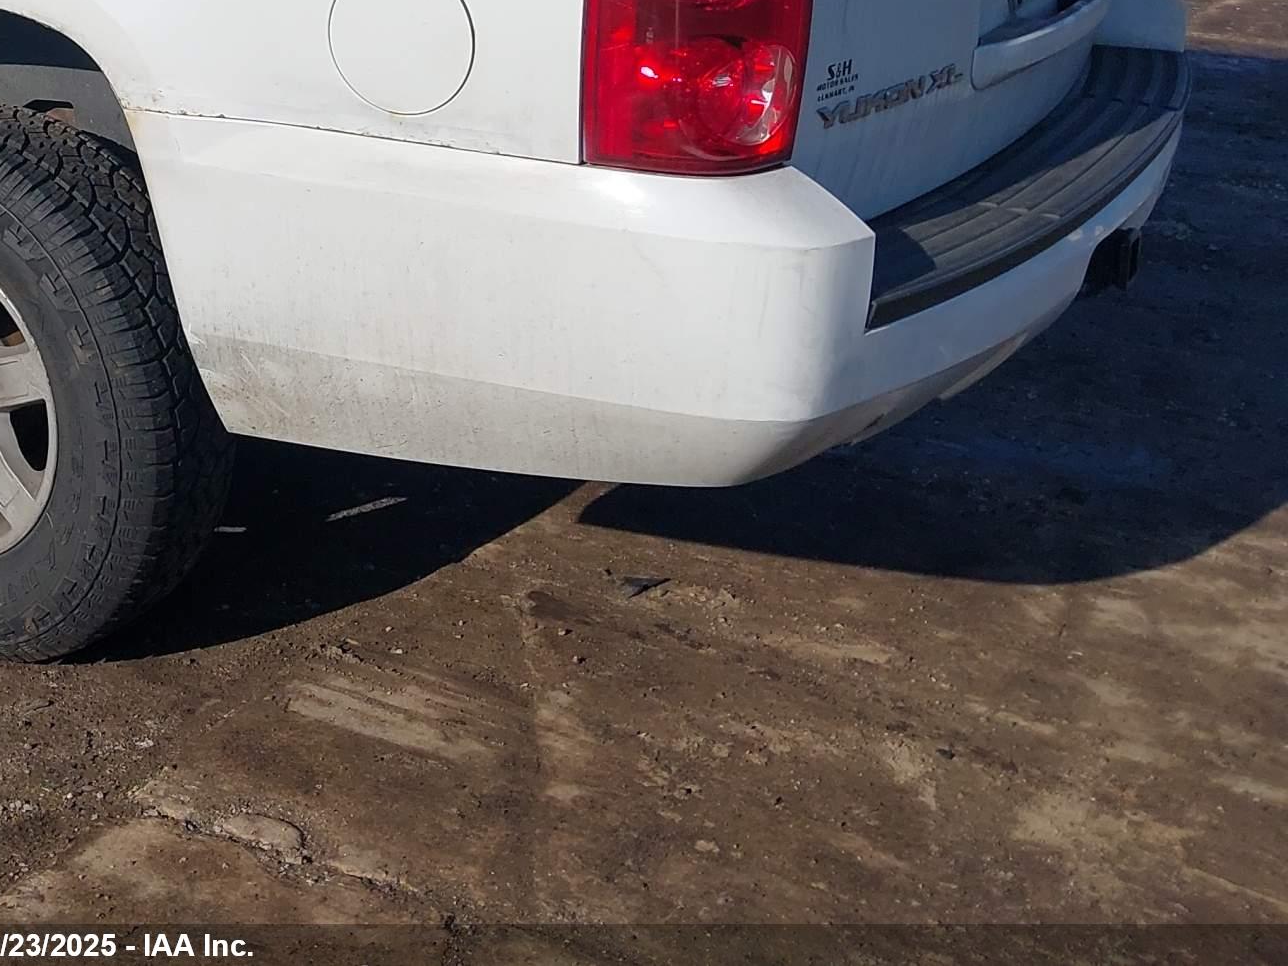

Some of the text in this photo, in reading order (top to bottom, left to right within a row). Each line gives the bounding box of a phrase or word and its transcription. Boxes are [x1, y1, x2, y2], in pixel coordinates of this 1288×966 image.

[826, 58, 853, 81] S&H
[816, 63, 963, 129] YUKON XL
